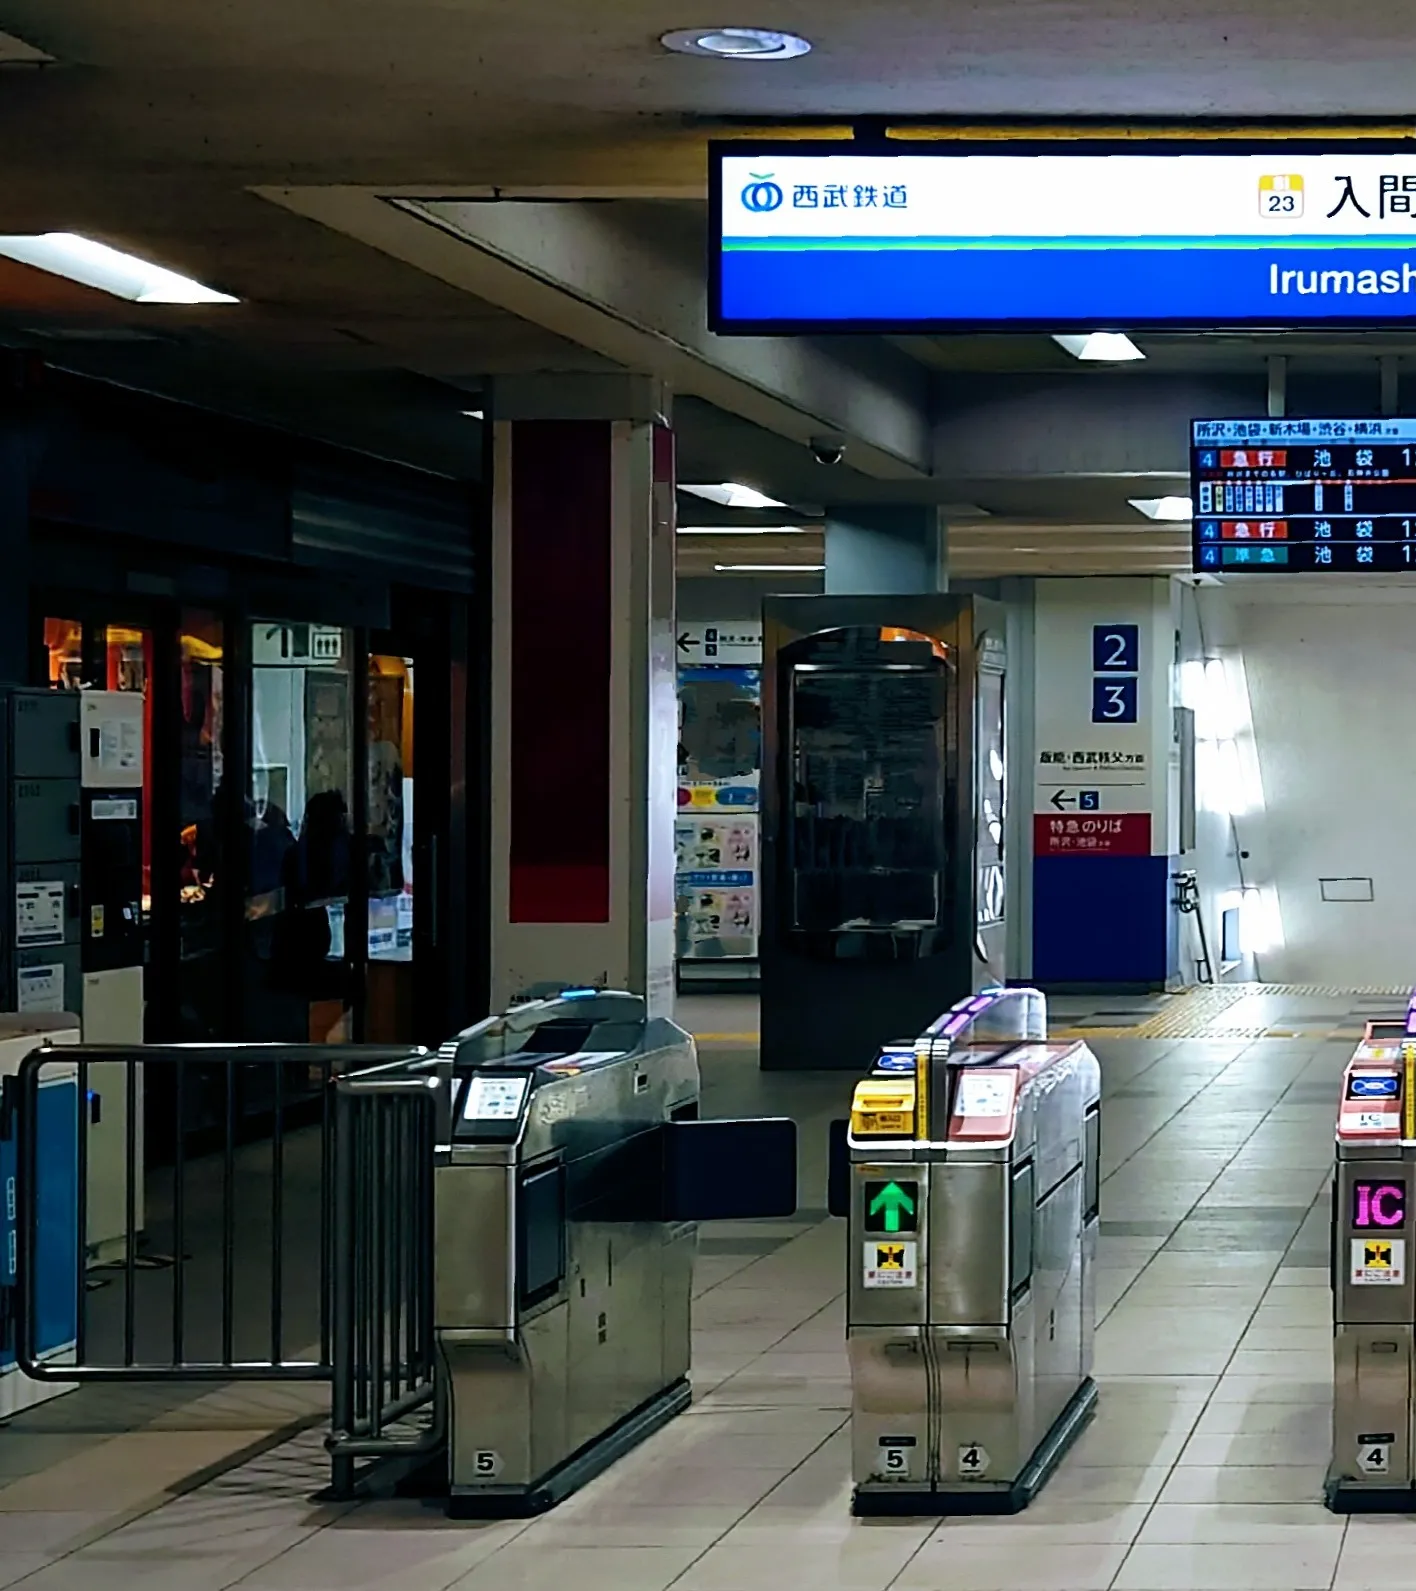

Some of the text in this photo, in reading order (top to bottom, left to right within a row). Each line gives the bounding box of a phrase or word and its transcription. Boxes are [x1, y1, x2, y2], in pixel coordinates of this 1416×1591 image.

[792, 183, 909, 210] 西武鉄道
[1268, 196, 1295, 212] 23
[1202, 453, 1213, 467] 4
[1233, 450, 1274, 467] 急行
[1313, 449, 1373, 467] 池袋
[1204, 524, 1214, 538] 4
[1234, 521, 1275, 539] 急行
[1314, 520, 1373, 538] 池袋
[1204, 549, 1214, 563] 4
[1314, 546, 1373, 564] 池袋
[1104, 634, 1127, 666] 2
[1103, 686, 1125, 718] 3
[1084, 793, 1094, 808] 5
[1356, 1186, 1403, 1226] IC
[477, 1452, 494, 1471] 5
[887, 1449, 903, 1468] 5
[962, 1448, 980, 1467] 4
[1366, 1448, 1384, 1465] 4
